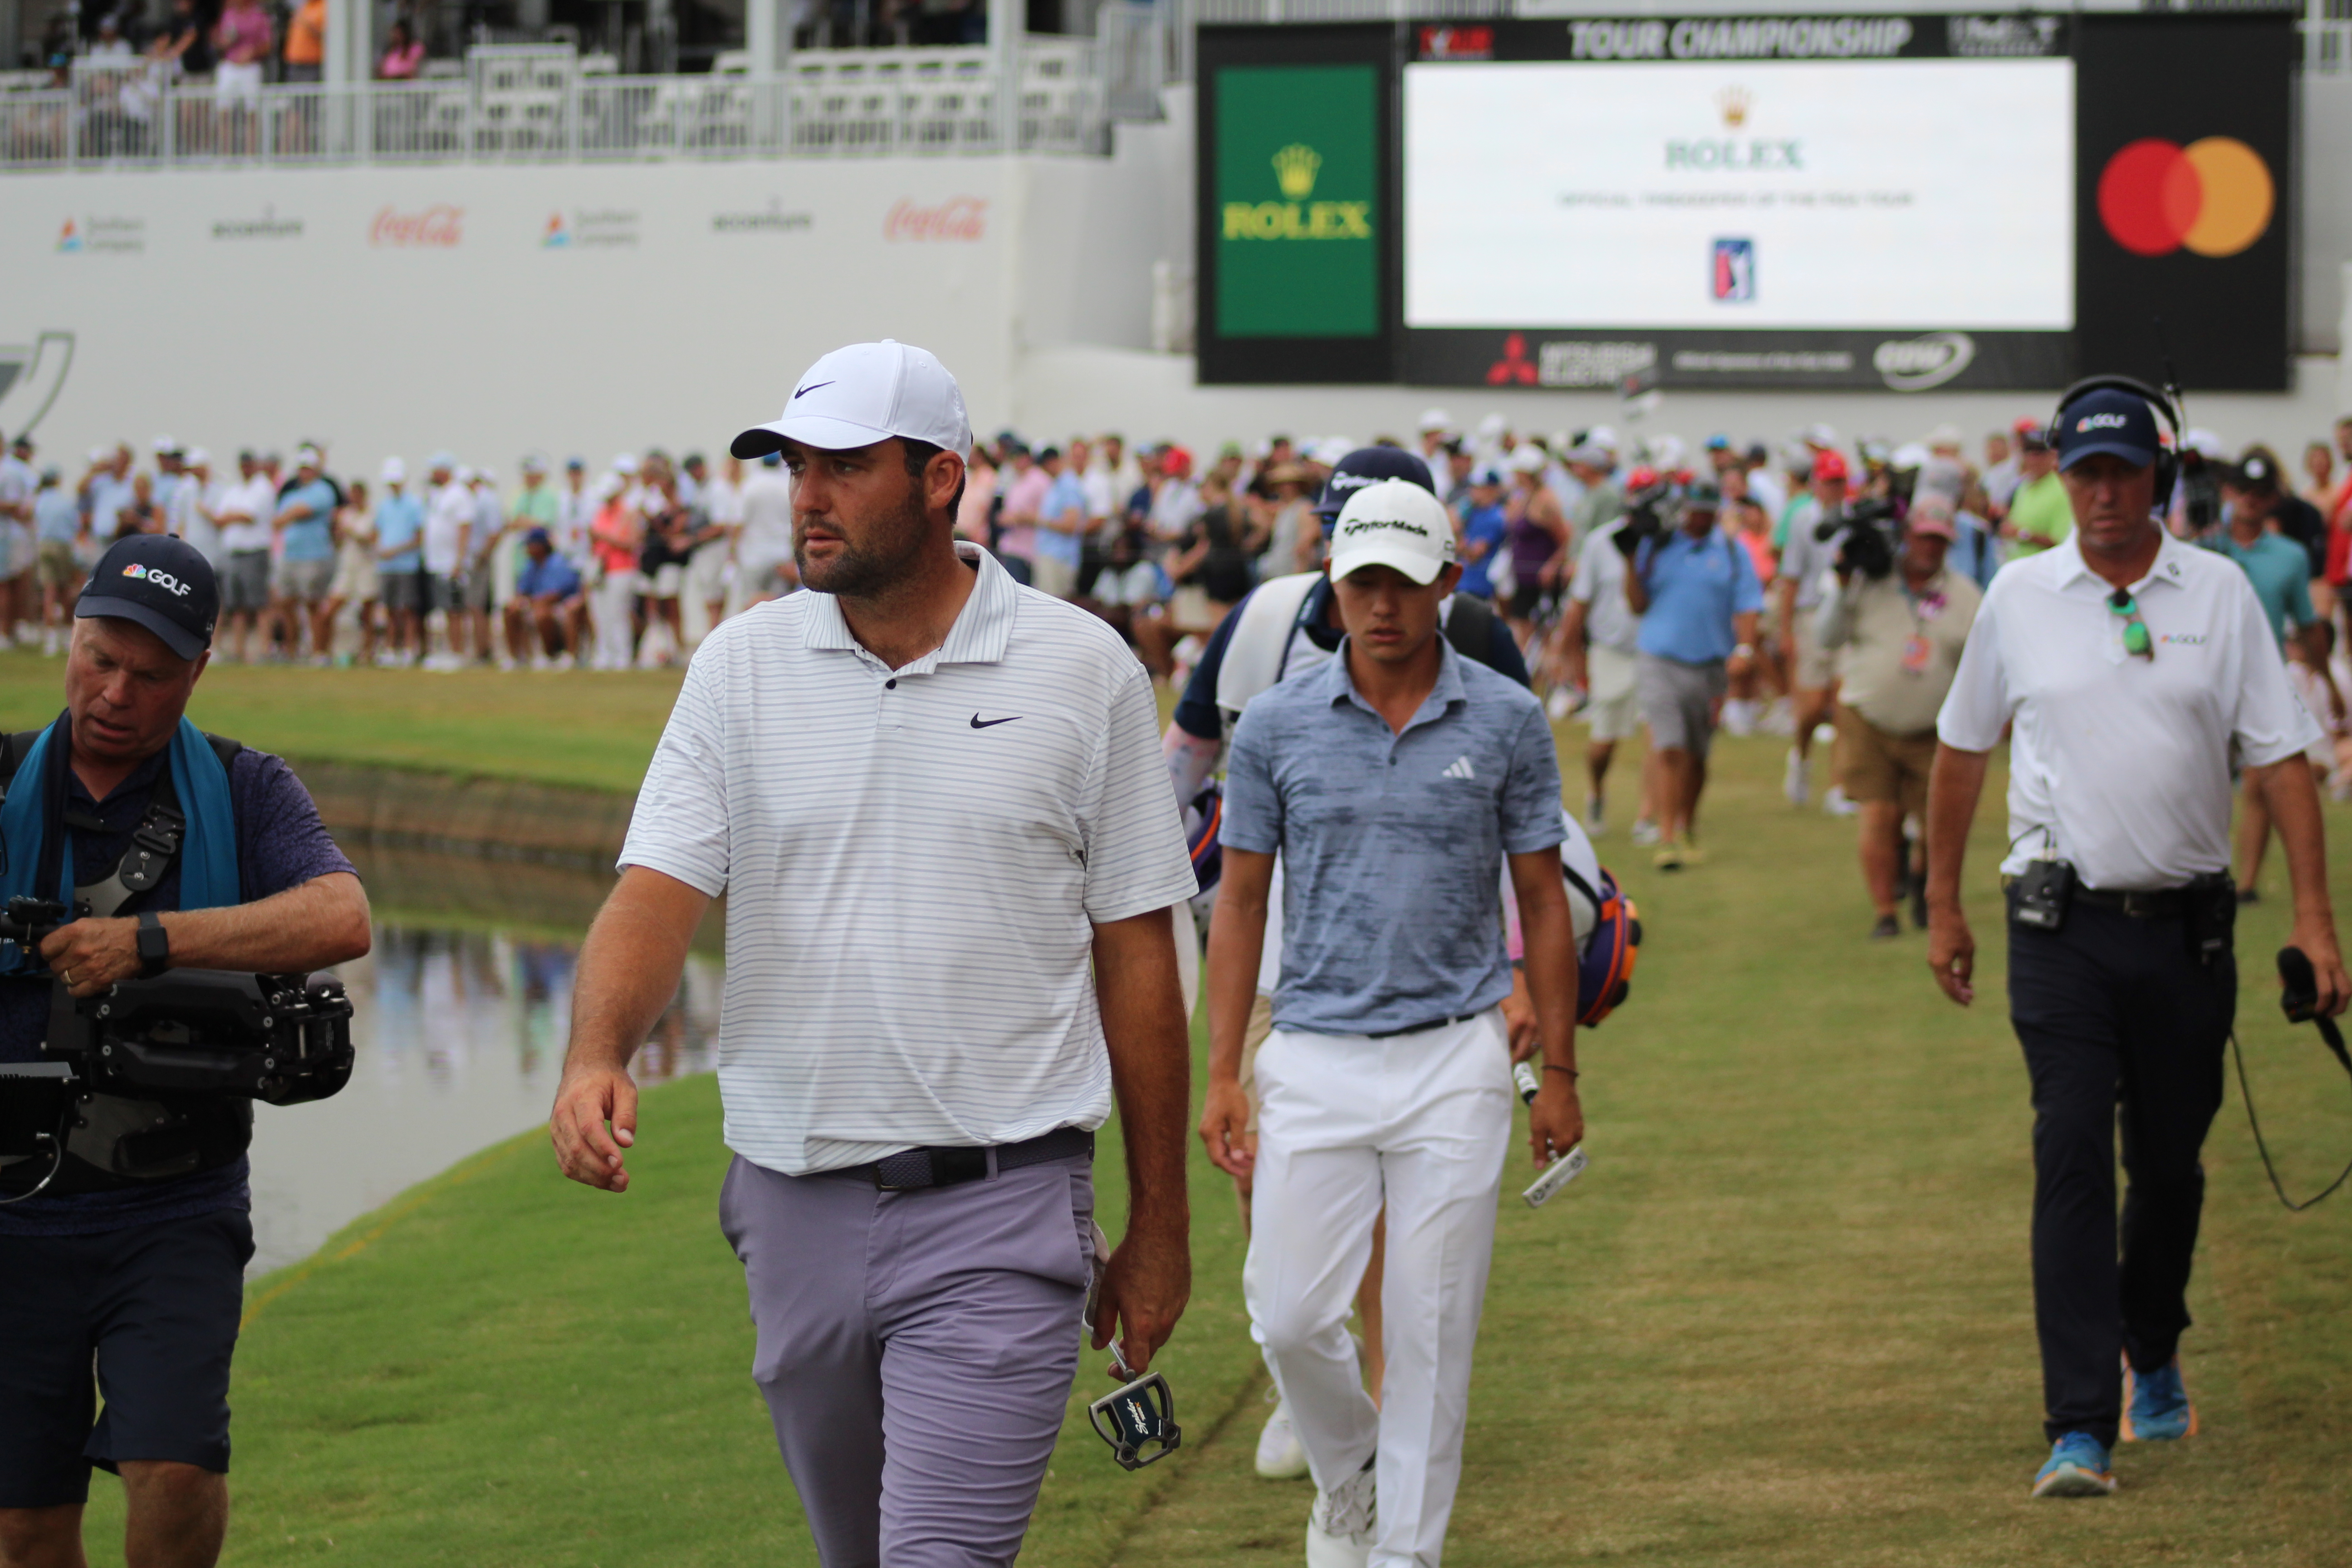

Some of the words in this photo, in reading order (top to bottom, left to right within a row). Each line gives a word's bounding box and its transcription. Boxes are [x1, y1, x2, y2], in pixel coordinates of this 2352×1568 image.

[1568, 20, 1667, 59] TOUR
[1670, 18, 1912, 59] CHAMPIONSHIP
[1664, 138, 1804, 170] ROLEX
[1224, 201, 1371, 240] ROLEX
[2092, 413, 2127, 429] GOLF
[1343, 519, 1429, 537] TaylorMade
[147, 568, 191, 597] GOLF
[1127, 1398, 1149, 1435] Spider
